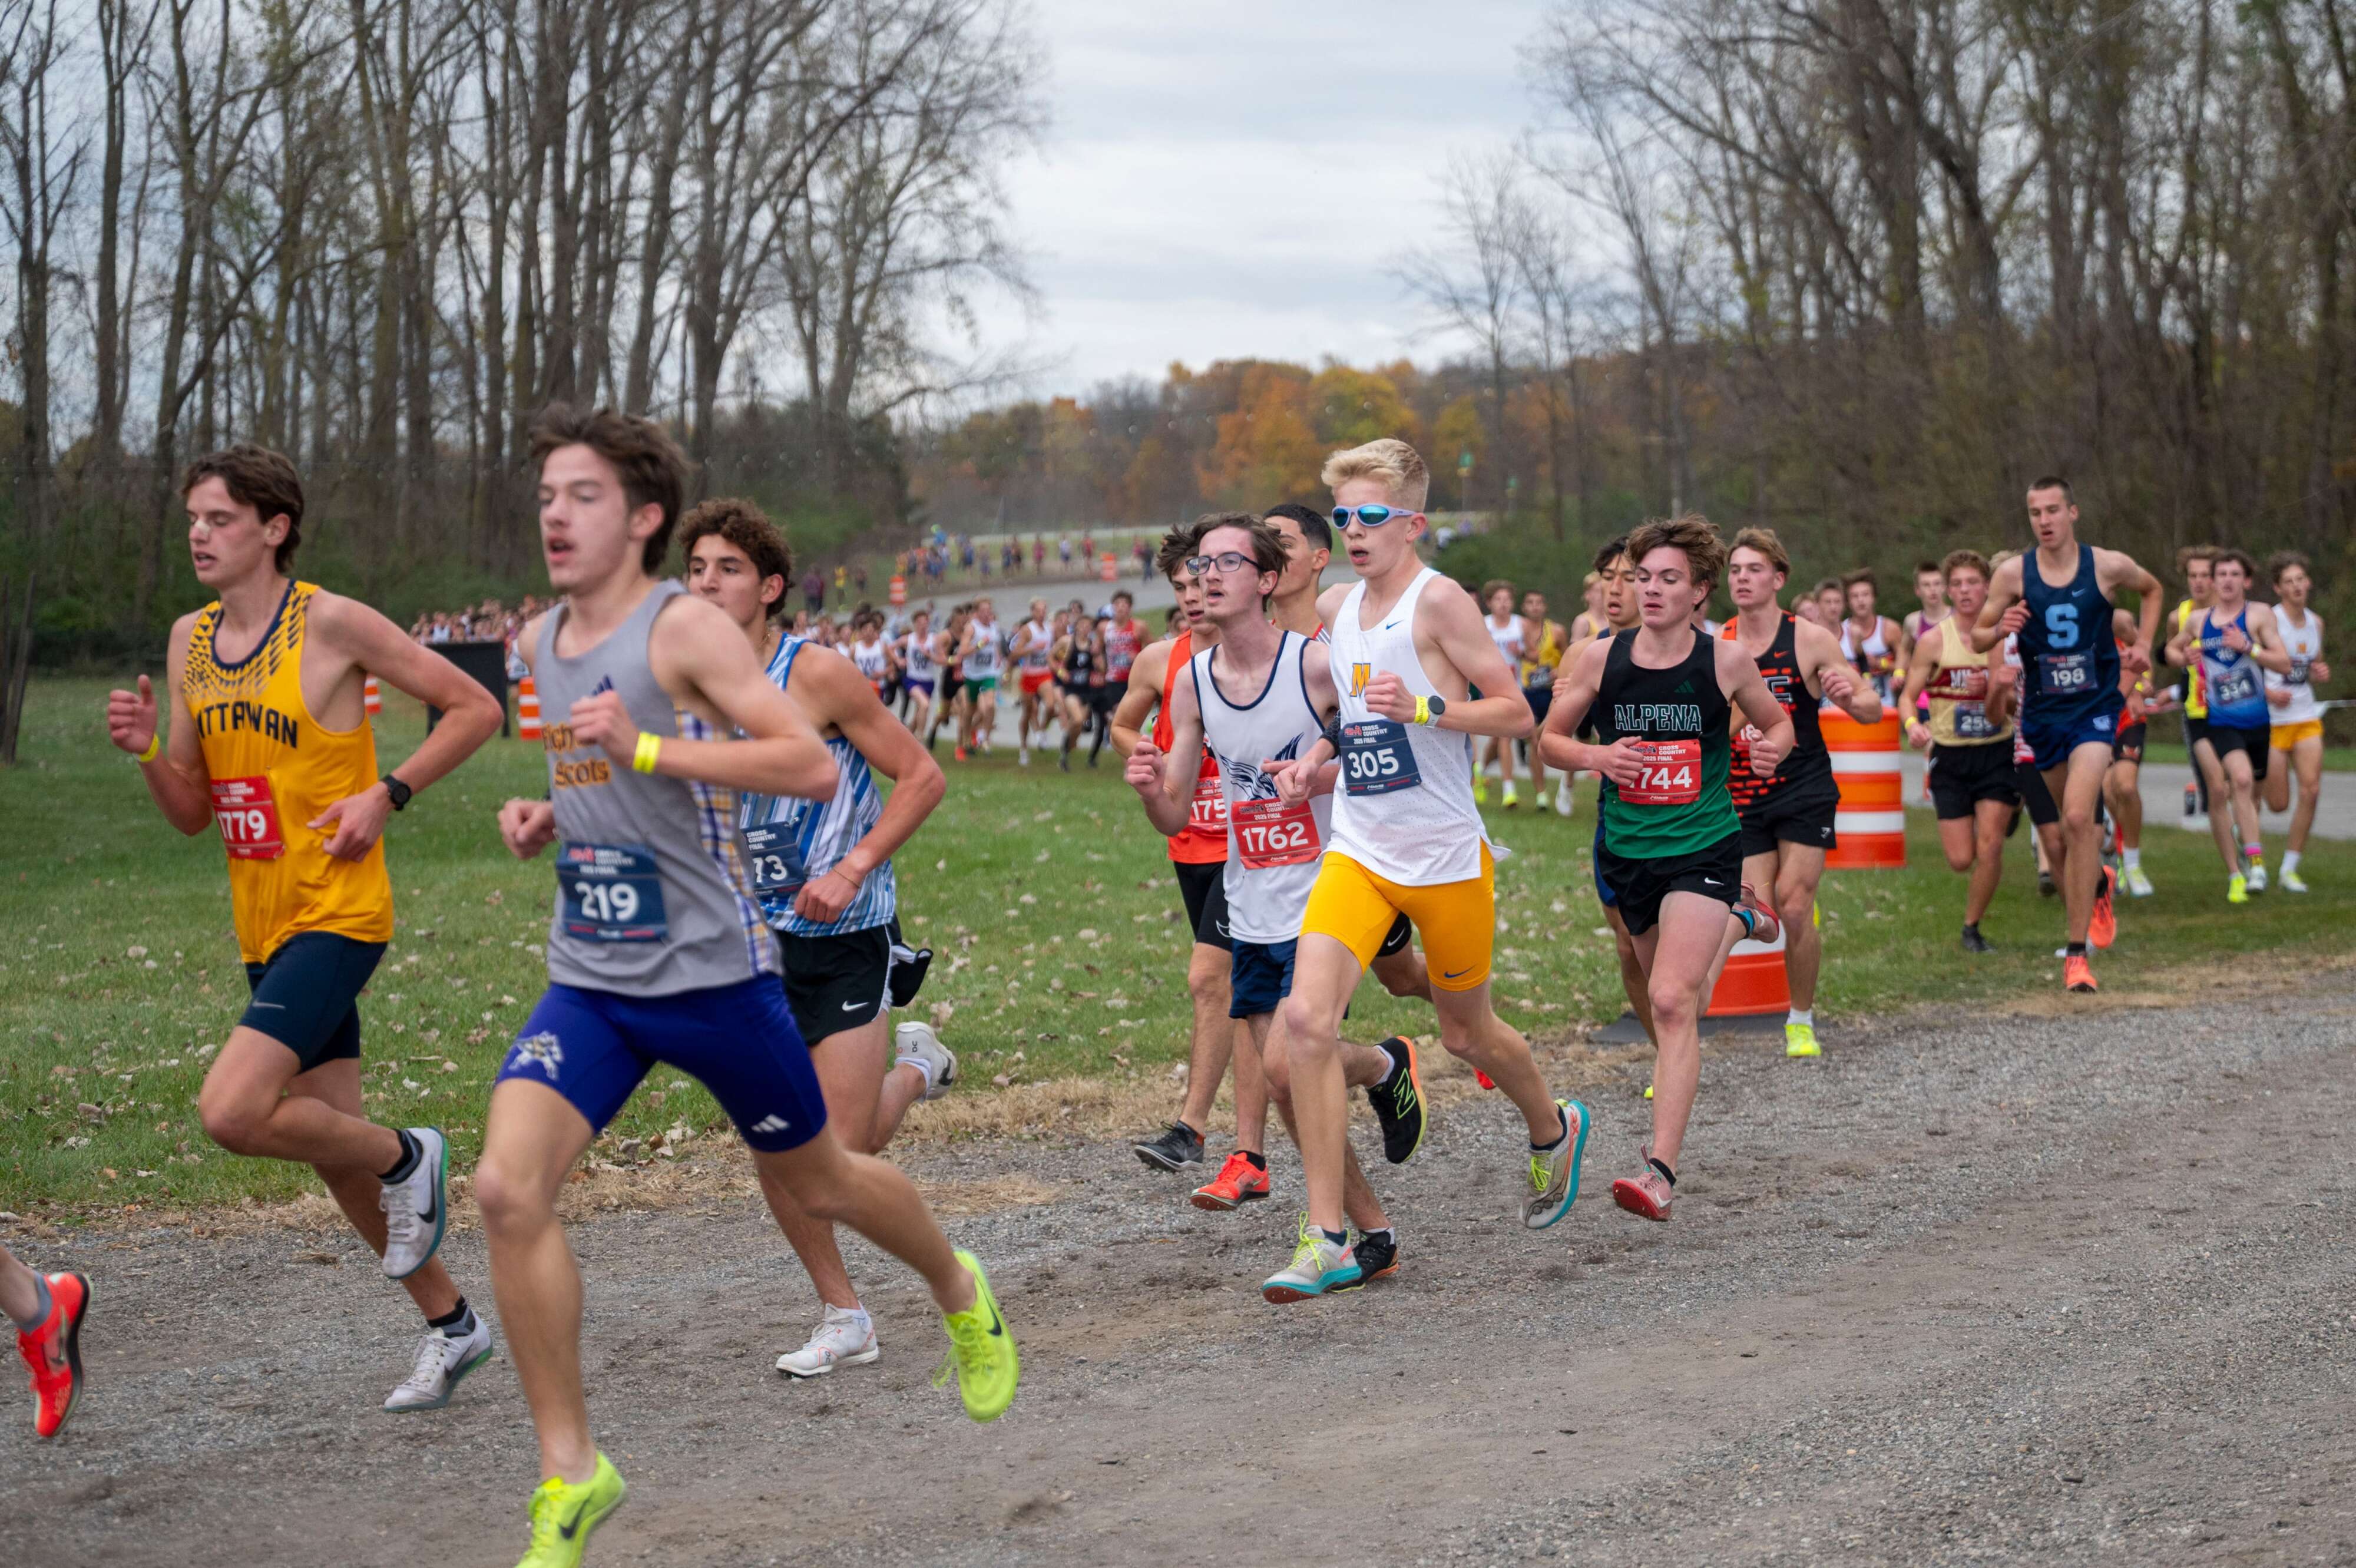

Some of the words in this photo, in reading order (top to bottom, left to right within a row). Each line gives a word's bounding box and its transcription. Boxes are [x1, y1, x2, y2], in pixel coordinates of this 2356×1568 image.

[2045, 603, 2078, 649] S
[1349, 663, 1371, 699] M
[2051, 668, 2085, 686] 198
[1363, 728, 1387, 736] COUNTRY
[1614, 704, 1702, 732] ALPENA
[1348, 747, 1398, 779] 305
[1629, 766, 1692, 789] 744
[746, 829, 767, 838] CROSS
[748, 833, 775, 843] COUNTRY
[1242, 822, 1308, 852] 1762
[575, 882, 639, 921] 219
